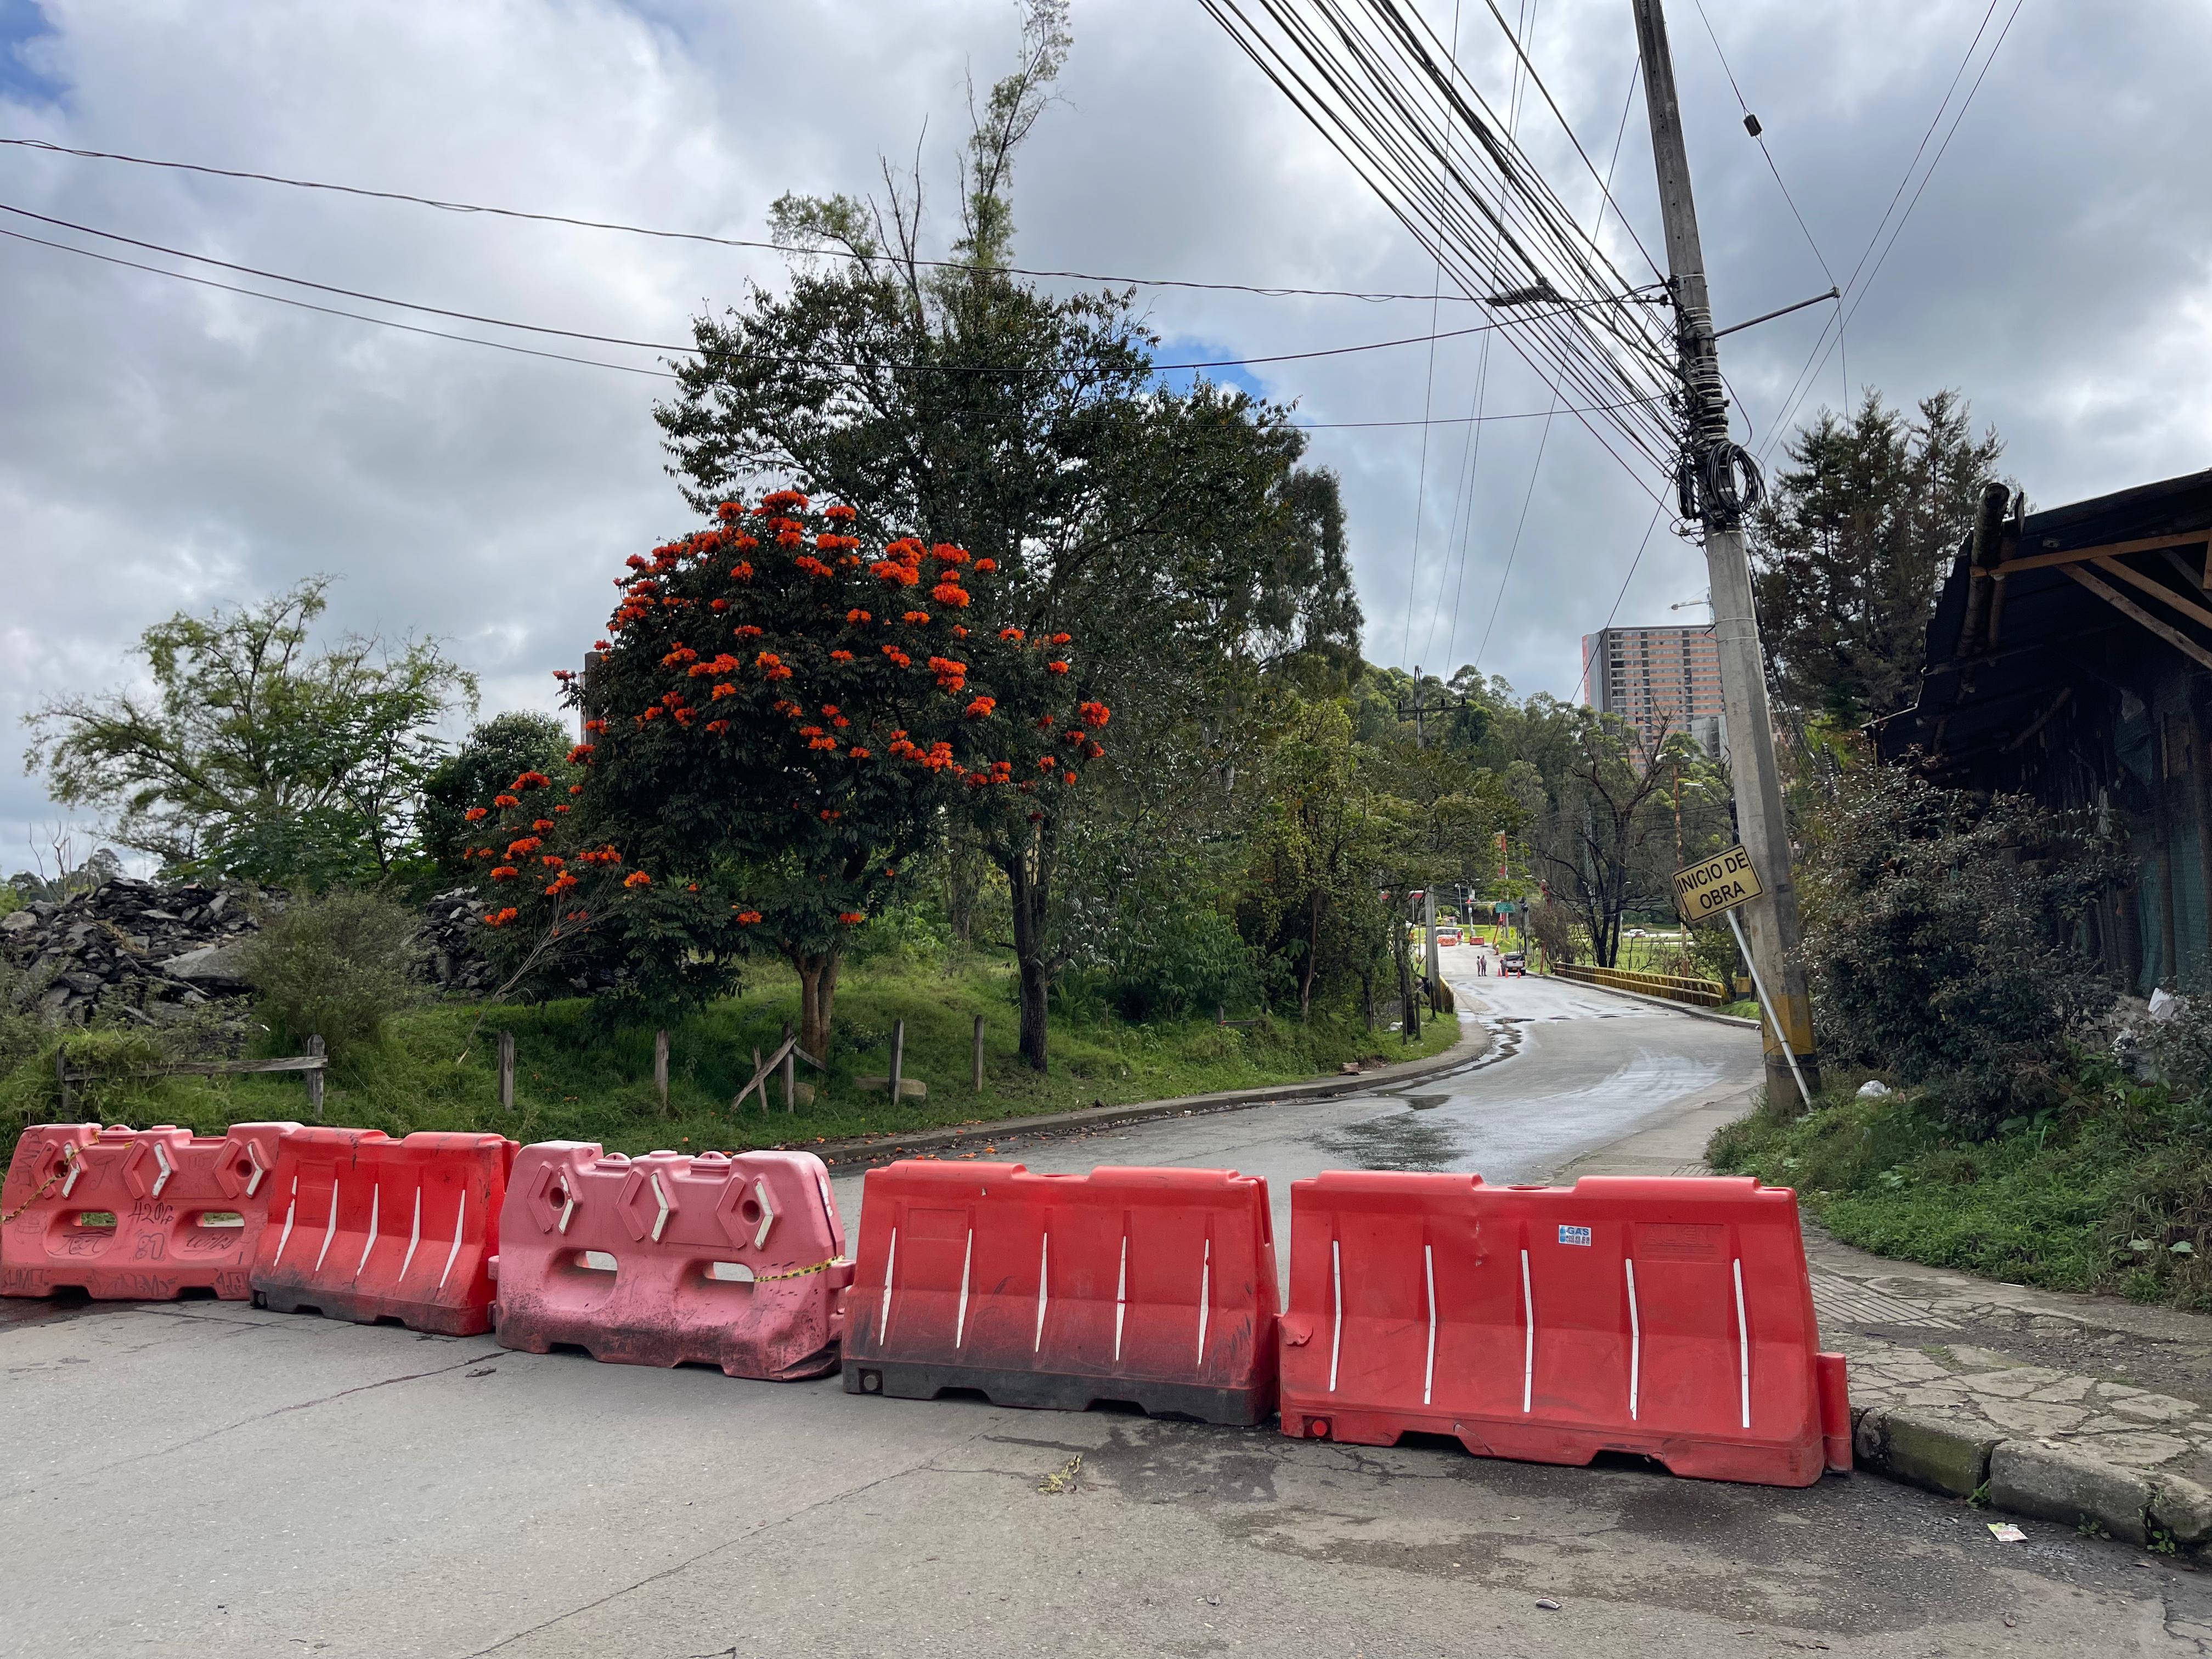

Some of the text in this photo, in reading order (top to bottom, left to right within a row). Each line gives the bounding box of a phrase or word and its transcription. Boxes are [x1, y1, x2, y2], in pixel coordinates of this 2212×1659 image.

[1677, 851, 1748, 894] INICIO DE
[1700, 881, 1746, 909] OBRA
[1568, 1227, 1589, 1235] GAS
